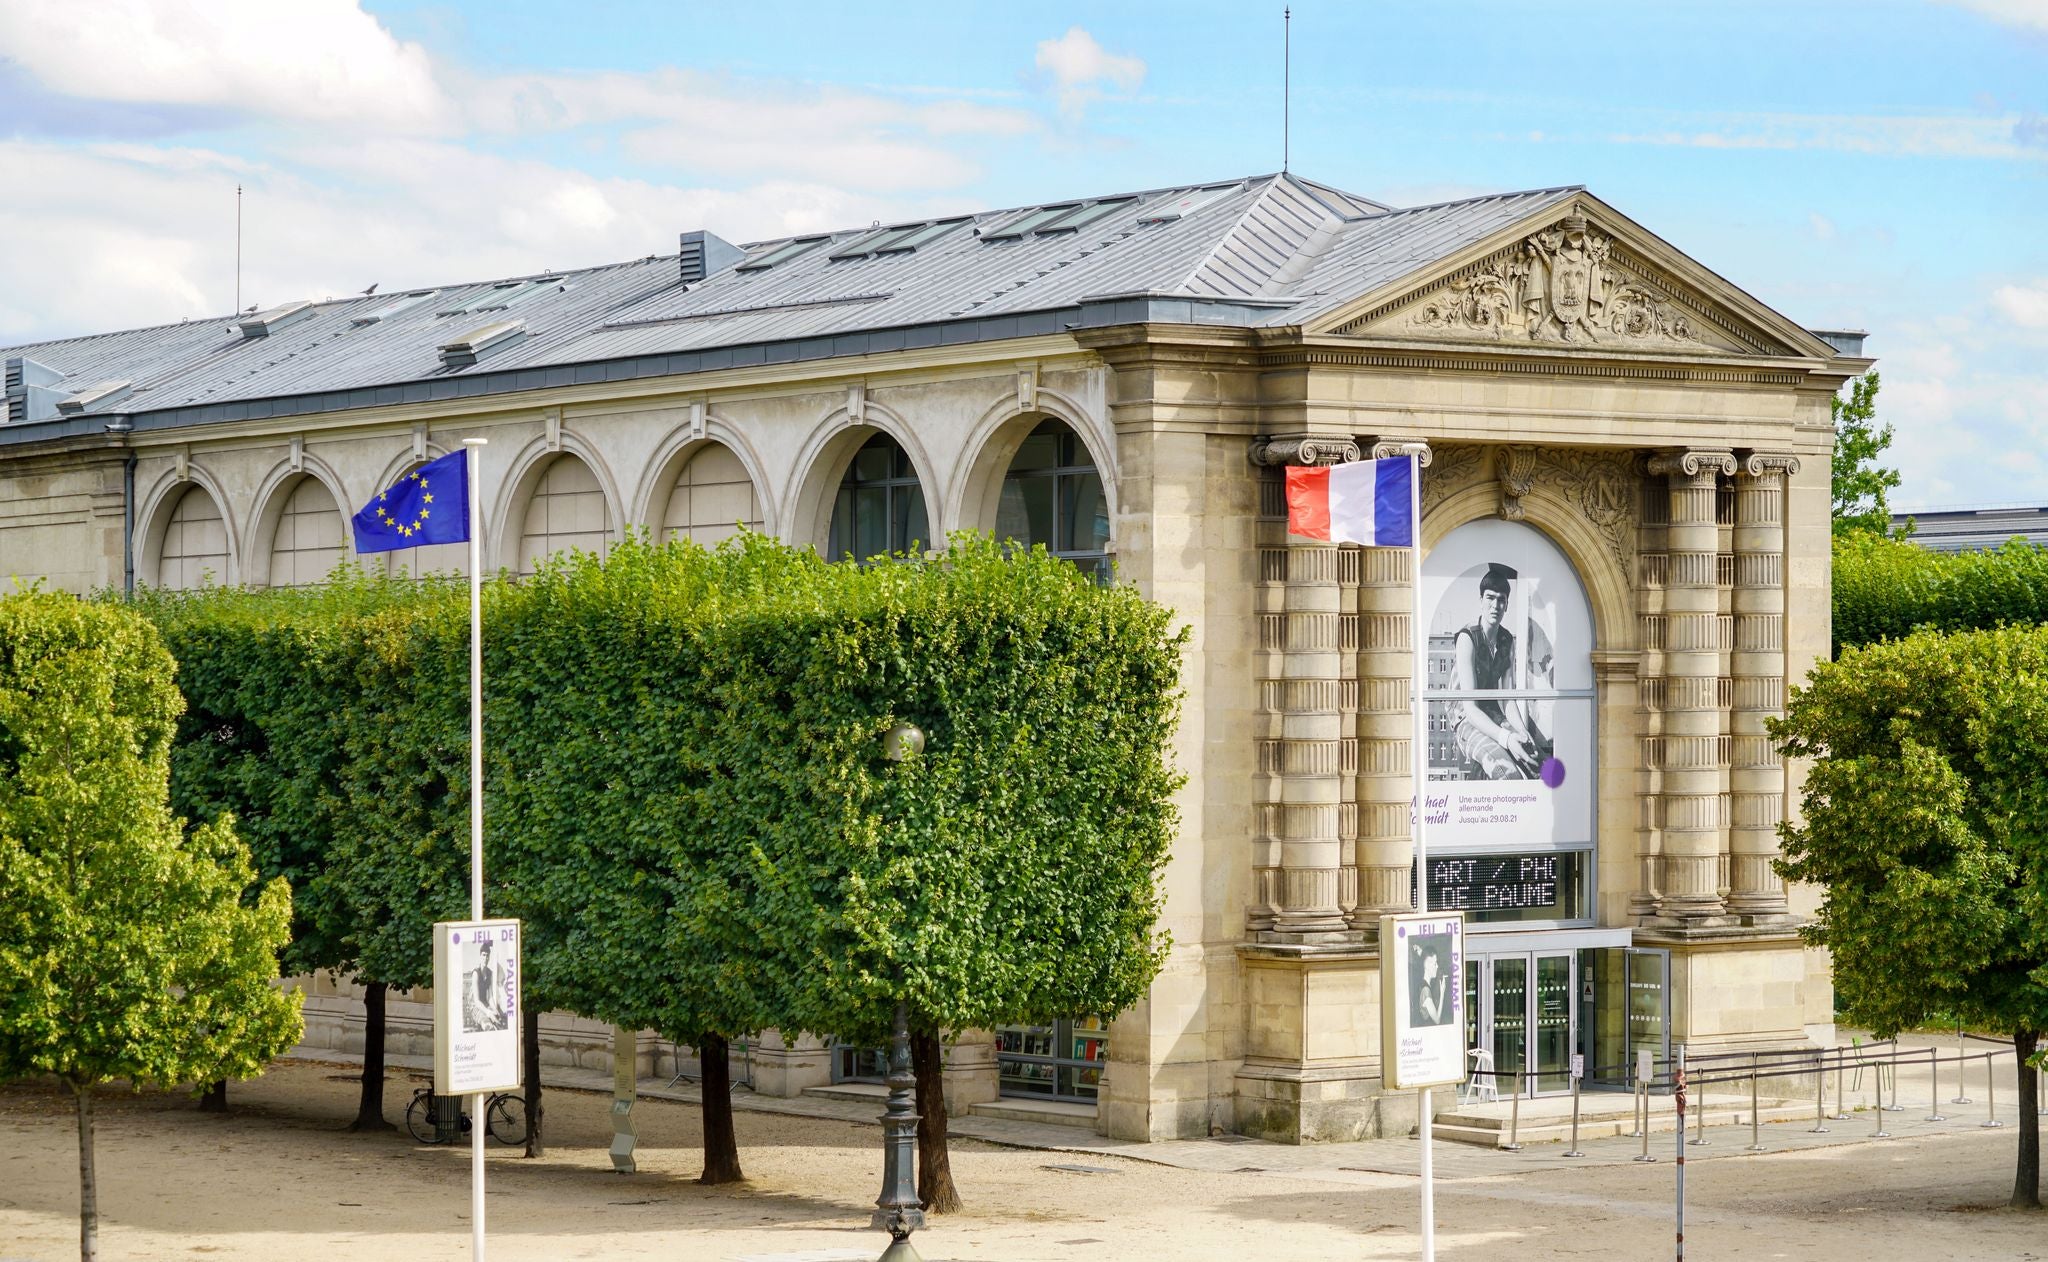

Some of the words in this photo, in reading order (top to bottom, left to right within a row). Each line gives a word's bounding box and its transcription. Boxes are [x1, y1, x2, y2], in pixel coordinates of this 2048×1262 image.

[1458, 795, 1472, 803] Une
[1493, 794, 1537, 804] photographie
[1458, 804, 1494, 812] allemande
[1490, 814, 1518, 823] 29.08.21
[1435, 860, 1477, 883] ART
[1442, 886, 1470, 909] DE
[1485, 882, 1555, 908] PAUME
[472, 930, 490, 944] JEU
[501, 929, 514, 941] DE
[1418, 923, 1435, 937] JEU
[1446, 922, 1459, 935] DE
[506, 959, 514, 1017] PAUME
[1451, 952, 1459, 1011] PAUME
